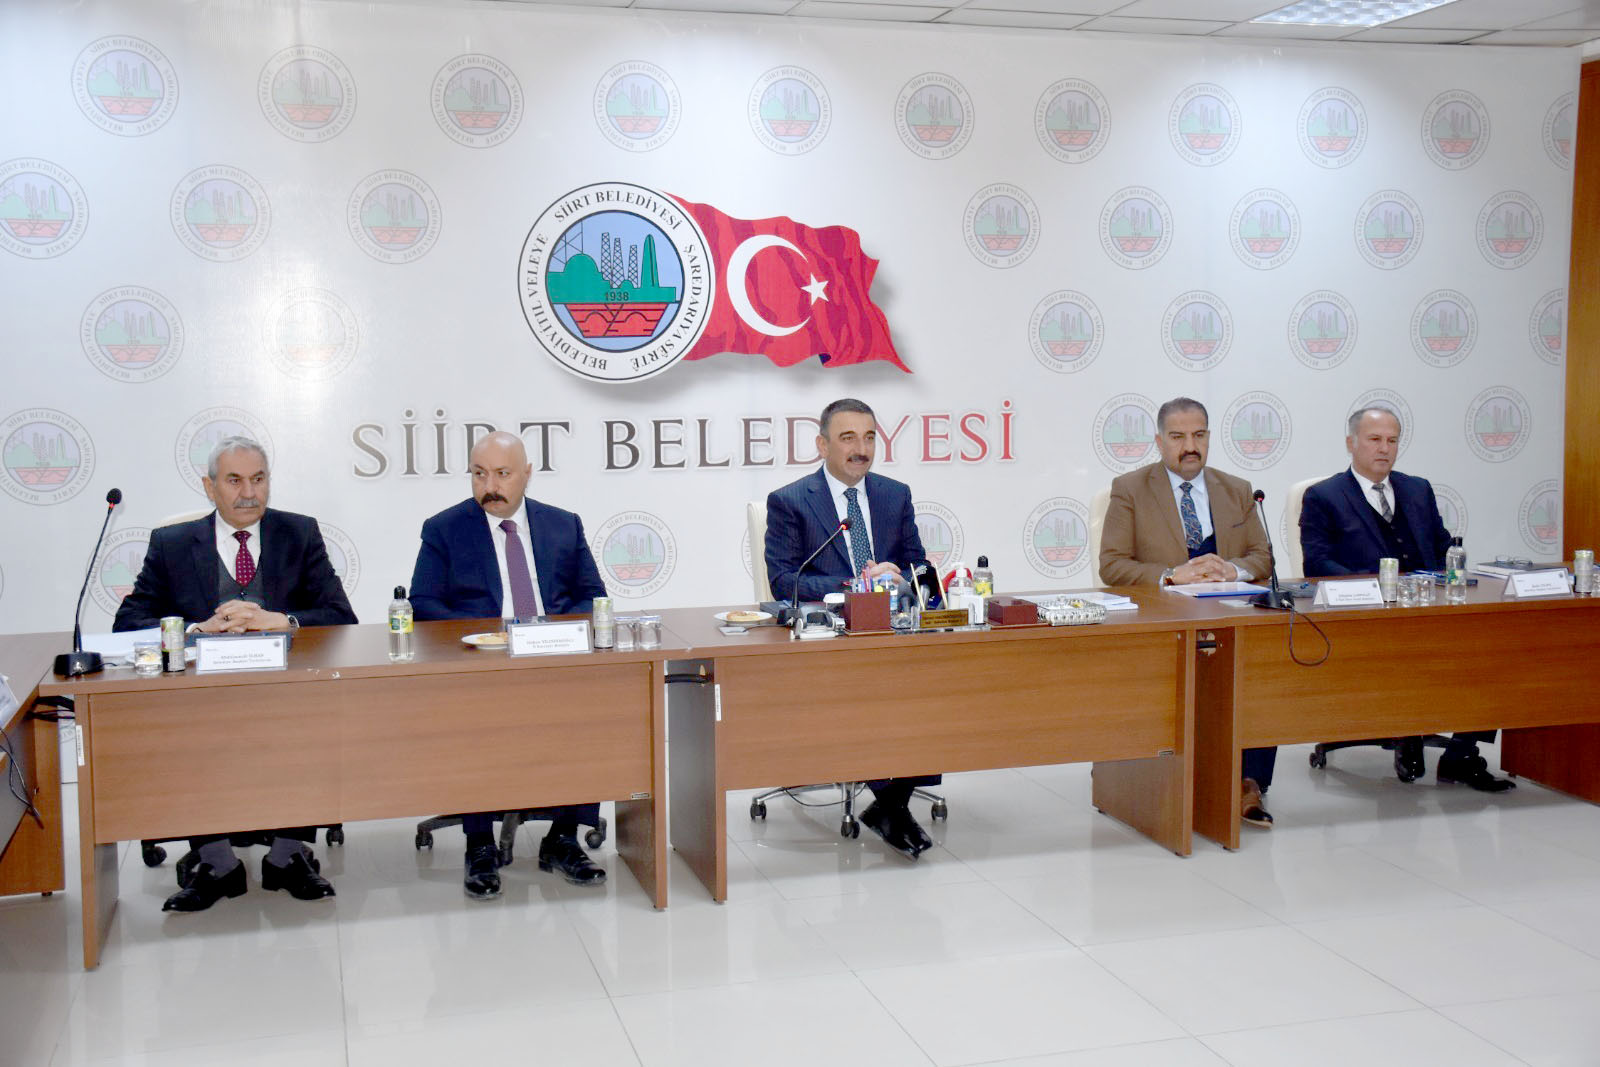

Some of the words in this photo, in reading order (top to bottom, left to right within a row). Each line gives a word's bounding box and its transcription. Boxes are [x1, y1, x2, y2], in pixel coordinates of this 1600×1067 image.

[554, 191, 591, 223] SİİRT
[595, 190, 682, 230] BELEDİYESİ
[528, 233, 548, 297] VELEYE
[604, 291, 629, 301] 1938
[604, 400, 1014, 470] BELEDYESİ
